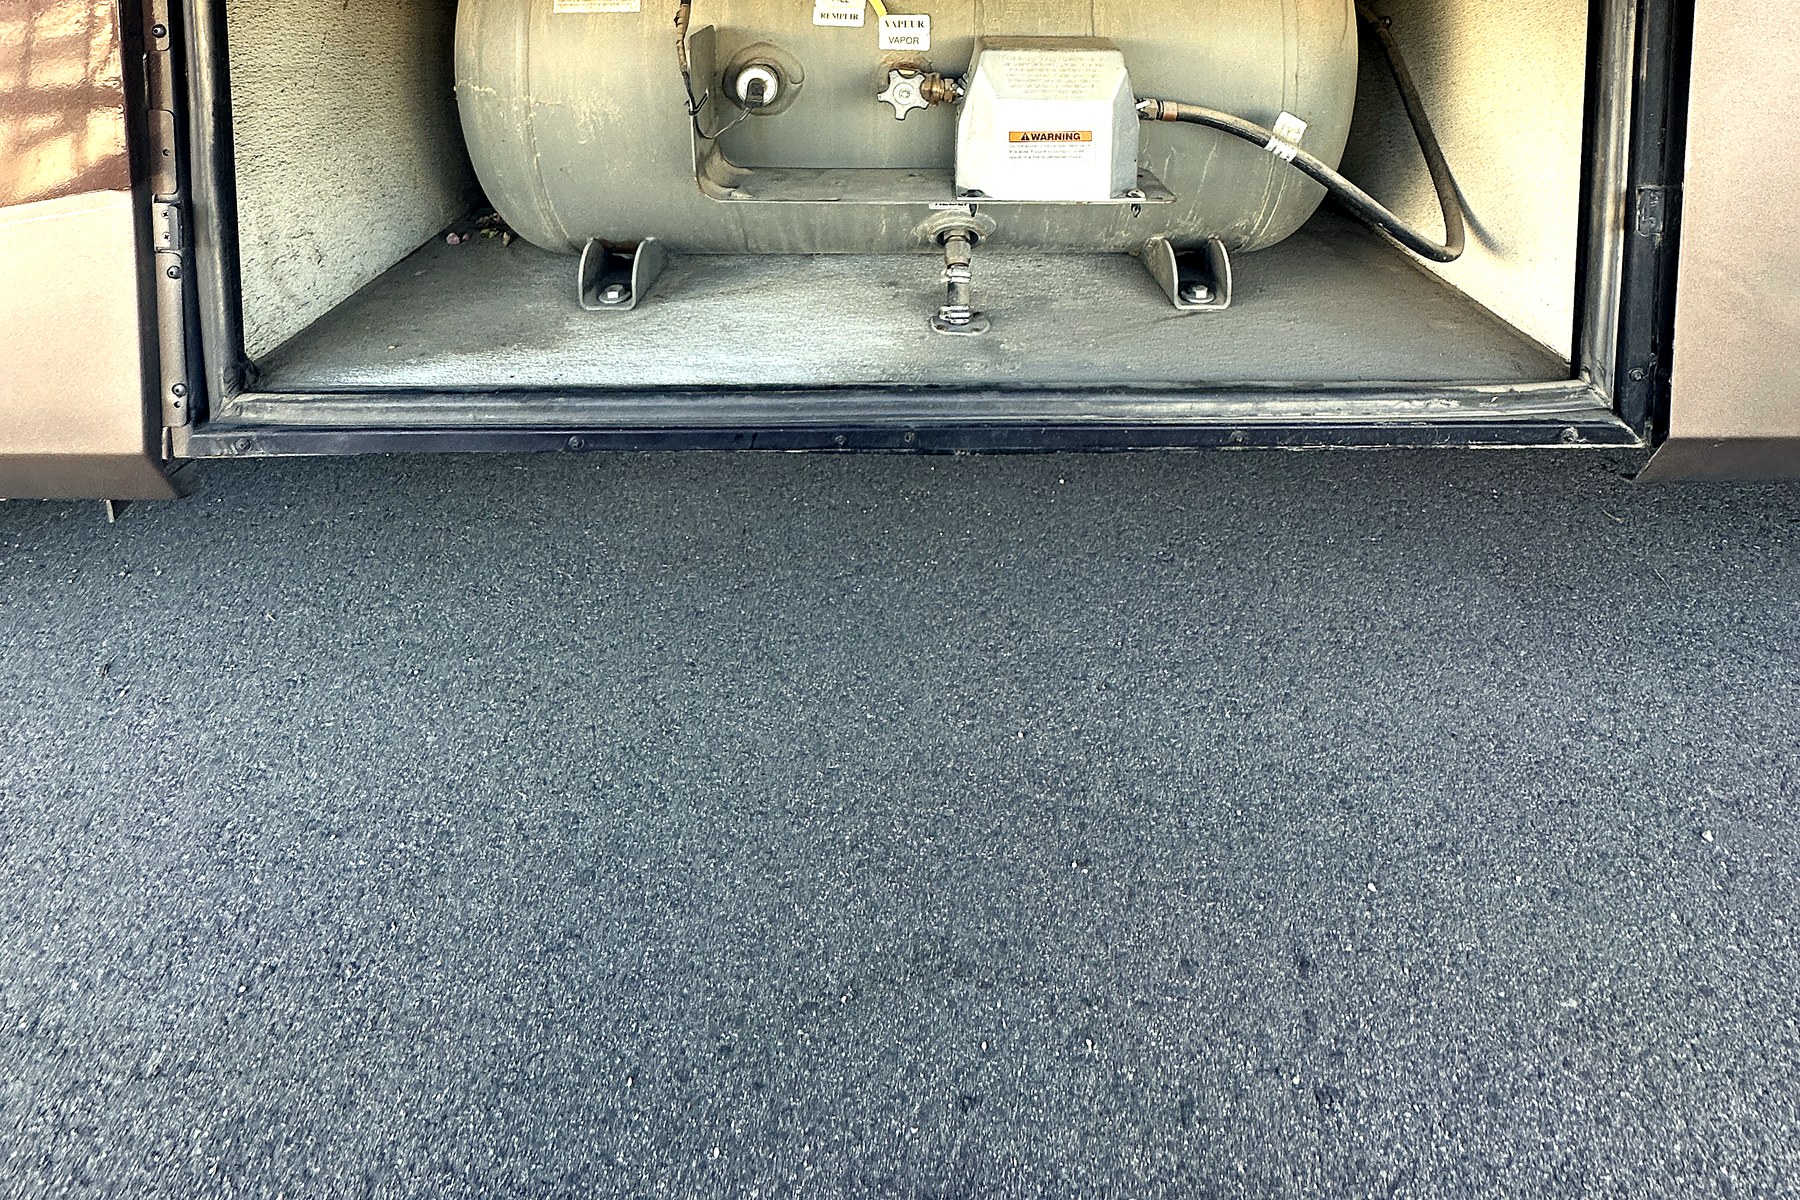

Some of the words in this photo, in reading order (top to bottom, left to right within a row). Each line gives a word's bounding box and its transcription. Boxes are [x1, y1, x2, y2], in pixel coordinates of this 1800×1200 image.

[885, 20, 925, 28] VAPEUR
[888, 36, 920, 45] VAPOR
[1031, 132, 1081, 141] WARNING
